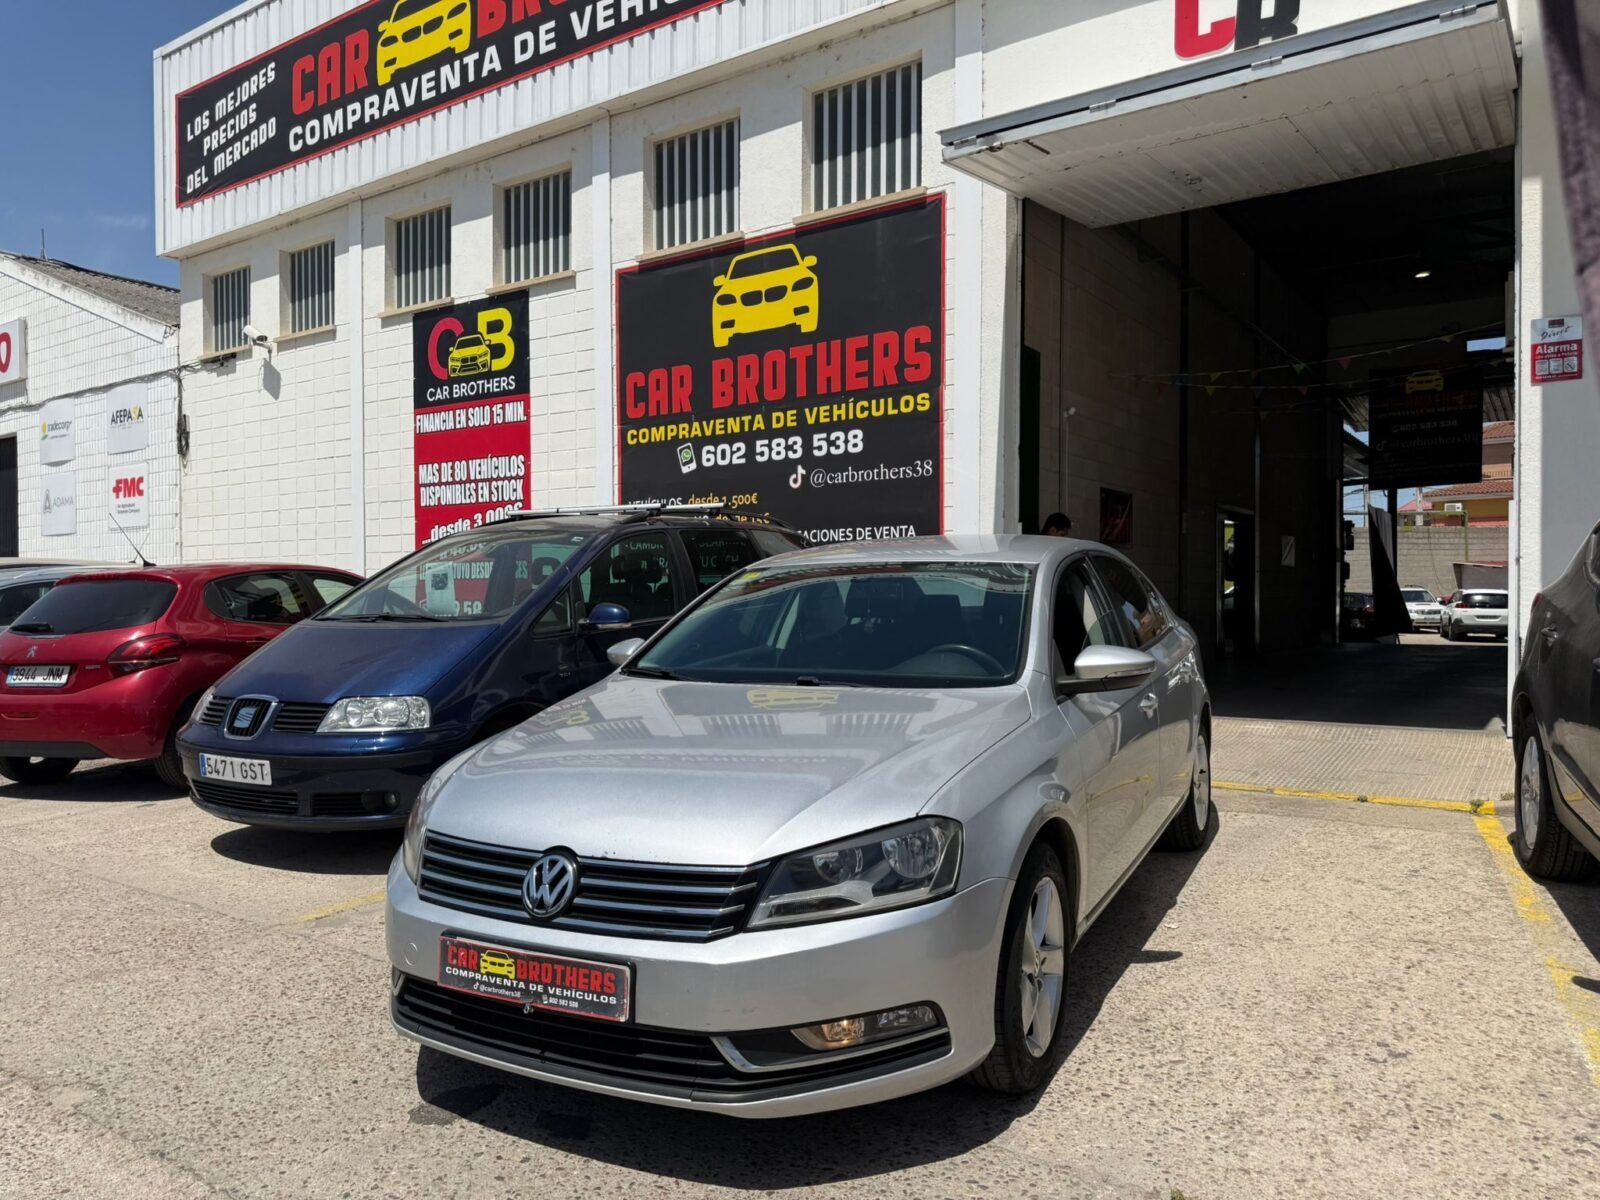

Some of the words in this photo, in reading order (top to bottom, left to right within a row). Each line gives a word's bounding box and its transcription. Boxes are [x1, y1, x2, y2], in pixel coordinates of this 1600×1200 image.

[289, 45, 502, 152] COMPRAVENTA
[514, 20, 556, 64] DE
[291, 28, 370, 116] CAR
[187, 110, 209, 142] LOS
[215, 61, 276, 122] MEJORES
[203, 102, 257, 157] PRECIOS
[187, 165, 209, 194] DEL
[214, 117, 276, 176] MERCADO
[1535, 343, 1578, 355] Alarma
[427, 385, 450, 402] CAR
[452, 375, 516, 399] BROTHERS
[626, 364, 693, 419] CAR
[712, 325, 932, 409] BROTHERS
[416, 410, 455, 434] FINANCIA
[455, 408, 467, 429] EN
[468, 405, 491, 427] SOLO
[492, 403, 504, 424] 15
[505, 400, 527, 423] MIN.
[626, 414, 765, 445] COMPRAVENTA
[772, 411, 797, 431] DE
[805, 392, 931, 425] VEHÍCULOS
[701, 443, 747, 468] 602
[755, 436, 804, 463] 583
[812, 429, 864, 457] 538
[419, 463, 440, 484] MAS
[441, 461, 453, 483] DE
[454, 460, 468, 482] 80
[469, 454, 525, 480] VEHÍCULOS
[810, 459, 933, 488] @carbrothers38
[112, 476, 144, 499] FMC
[420, 483, 476, 507] DISPONIBLES
[478, 481, 490, 503] EN
[491, 478, 524, 502] STOCK
[856, 528, 872, 541] DE
[874, 525, 916, 540] VENTA
[13, 667, 37, 681] 3944
[206, 757, 236, 778] 5471
[240, 762, 266, 781] GST
[446, 966, 526, 990] COMPRAVENTA
[529, 982, 544, 993] DE
[548, 986, 617, 1005] VEHÍCULOS
[447, 945, 478, 970] CAR
[516, 959, 616, 994] BROTHERS
